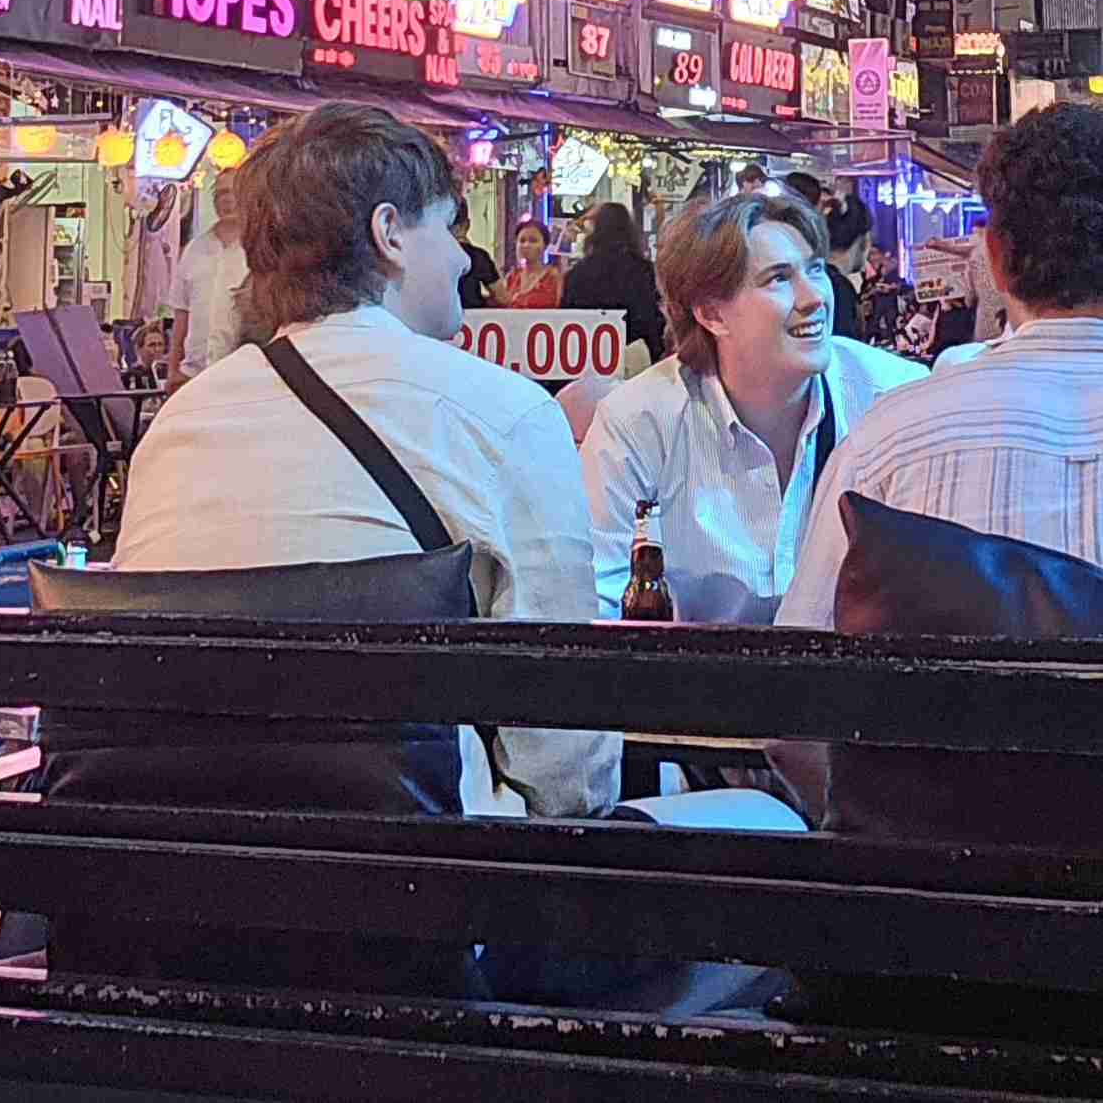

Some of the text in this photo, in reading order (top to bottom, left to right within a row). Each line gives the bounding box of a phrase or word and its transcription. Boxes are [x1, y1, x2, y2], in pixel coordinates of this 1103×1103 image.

[580, 23, 610, 58] 87
[425, 54, 460, 87] NAIL
[673, 51, 704, 86] 89
[730, 42, 796, 92] COLD BEER
[450, 322, 620, 376] 0.000
